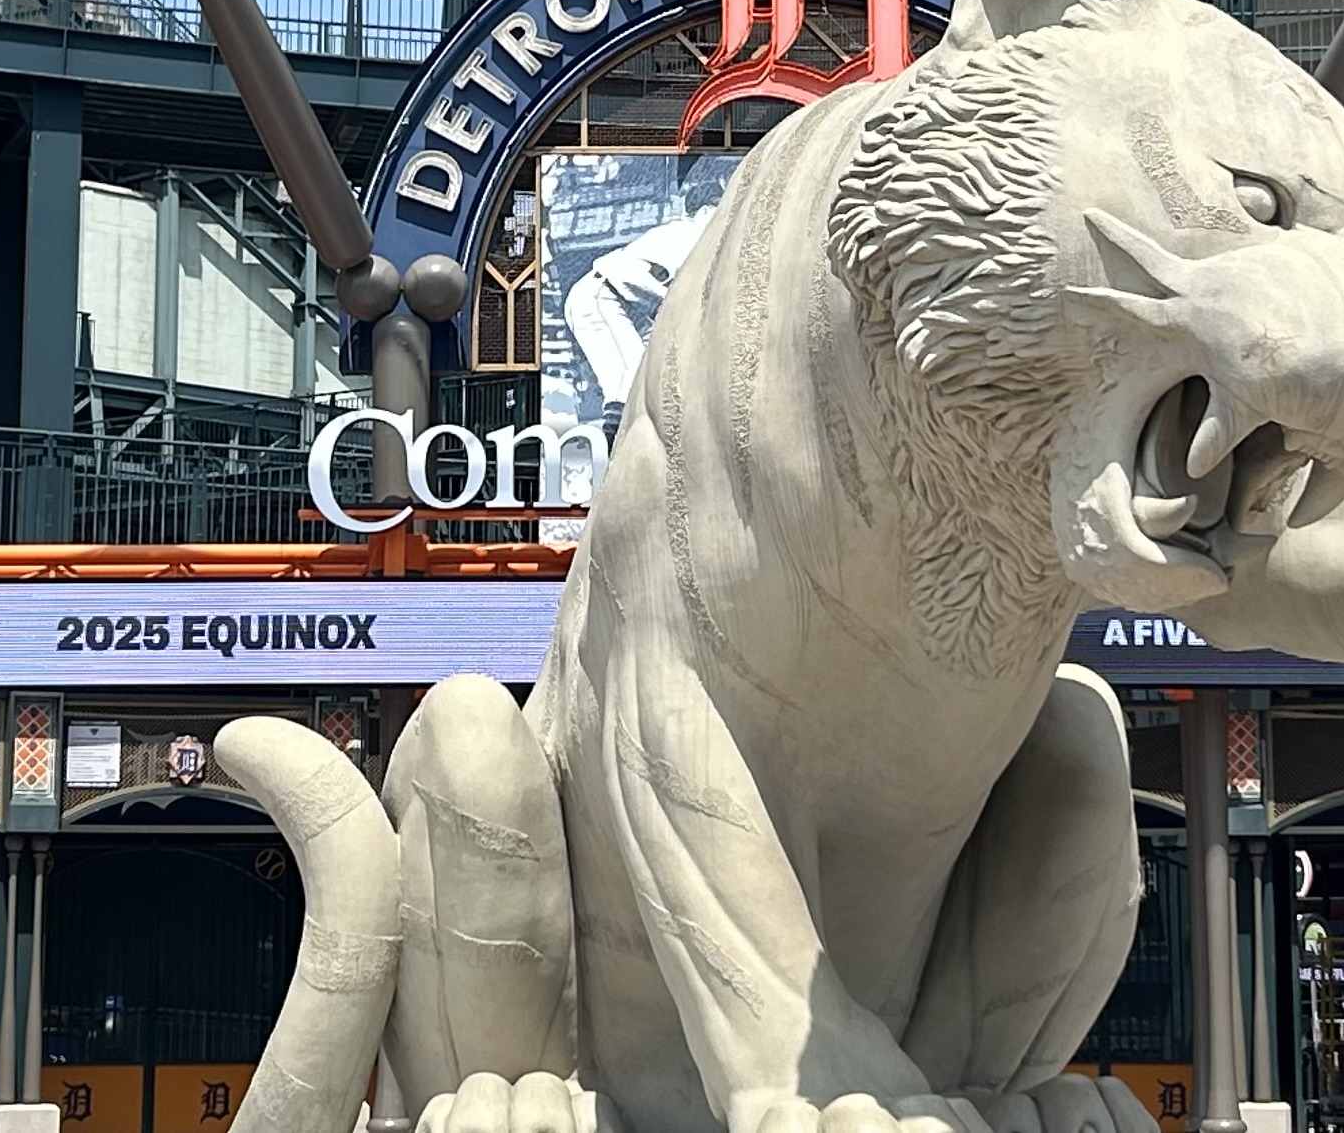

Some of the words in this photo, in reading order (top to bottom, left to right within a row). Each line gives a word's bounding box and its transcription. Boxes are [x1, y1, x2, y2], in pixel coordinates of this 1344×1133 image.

[56, 615, 170, 651] 2025
[181, 614, 377, 657] EQUINOX
[1103, 619, 1128, 646] A
